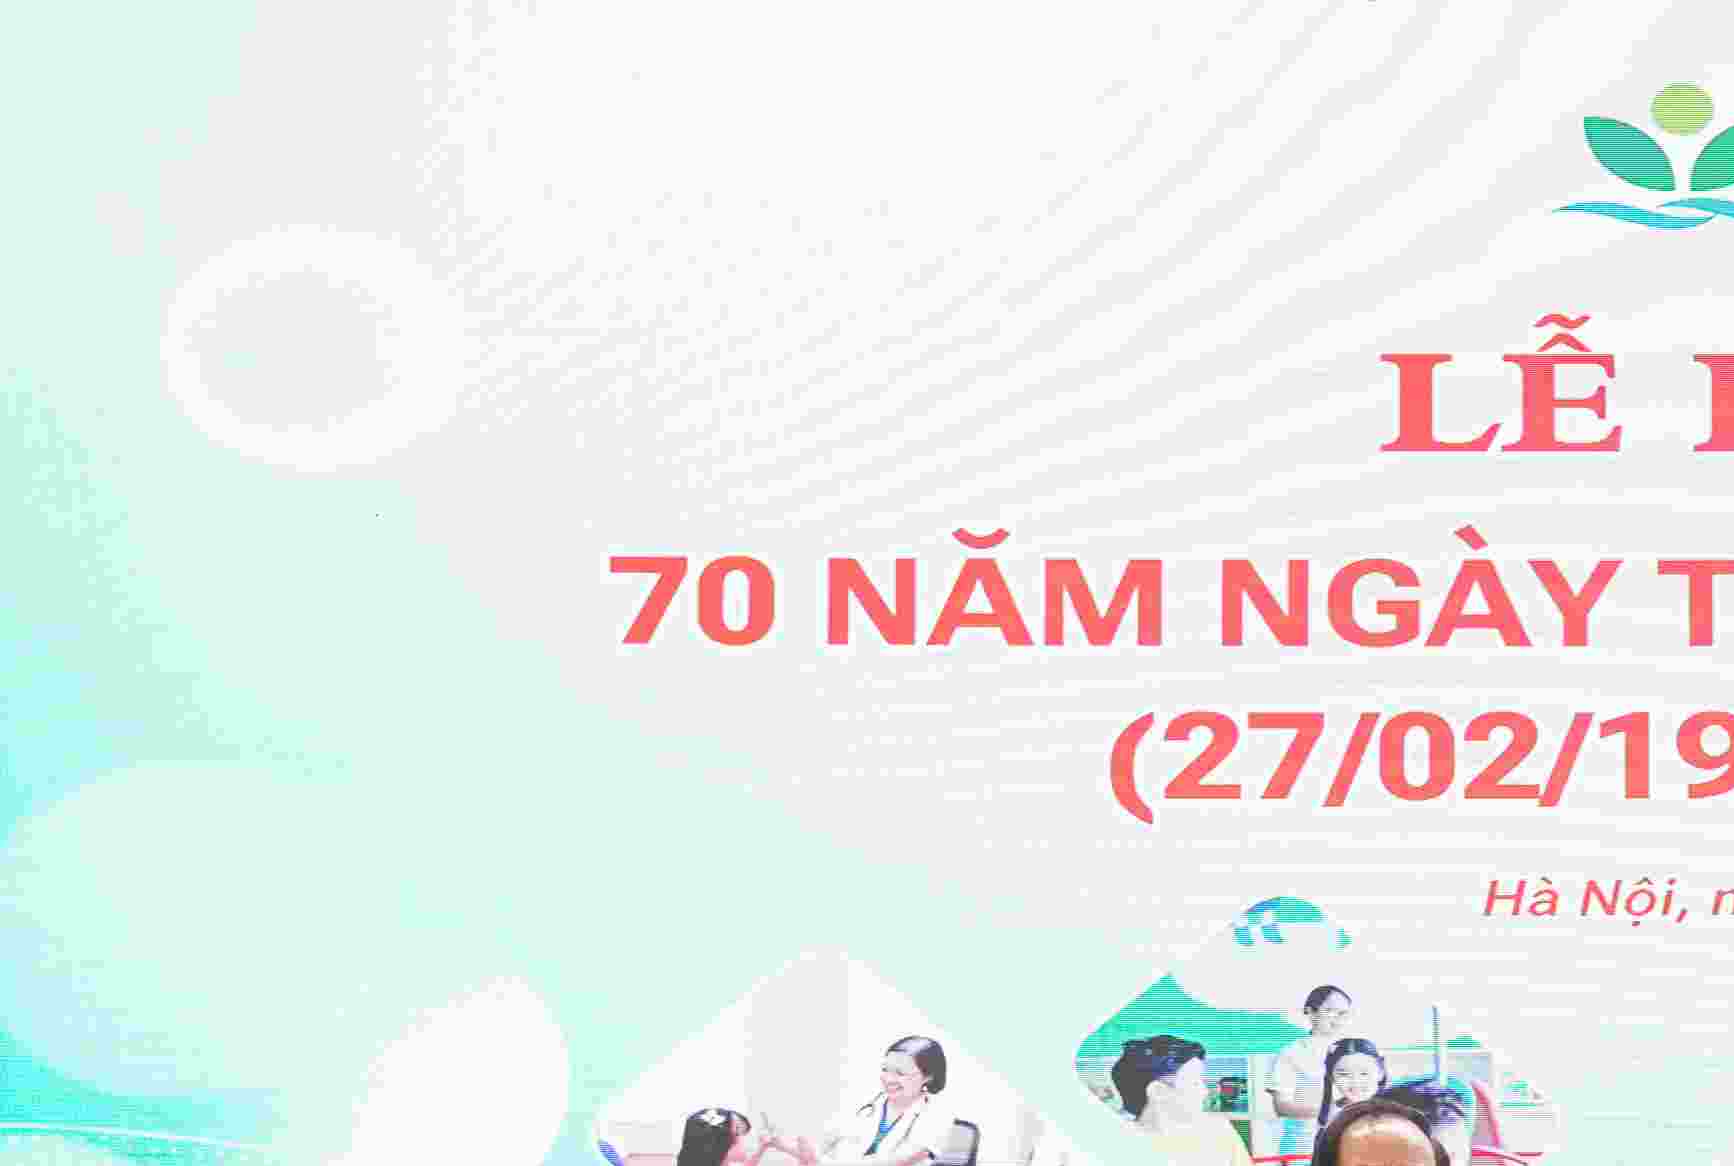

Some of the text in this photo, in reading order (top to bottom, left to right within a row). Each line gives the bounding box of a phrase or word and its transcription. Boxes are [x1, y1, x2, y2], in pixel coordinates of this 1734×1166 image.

[1378, 313, 1624, 453] LỄ
[609, 556, 776, 647] 70
[826, 527, 1163, 648] NĂM
[1221, 527, 1624, 649] NGÀY
[1484, 878, 1561, 917] Hà
[1582, 878, 1689, 928] Nội,
